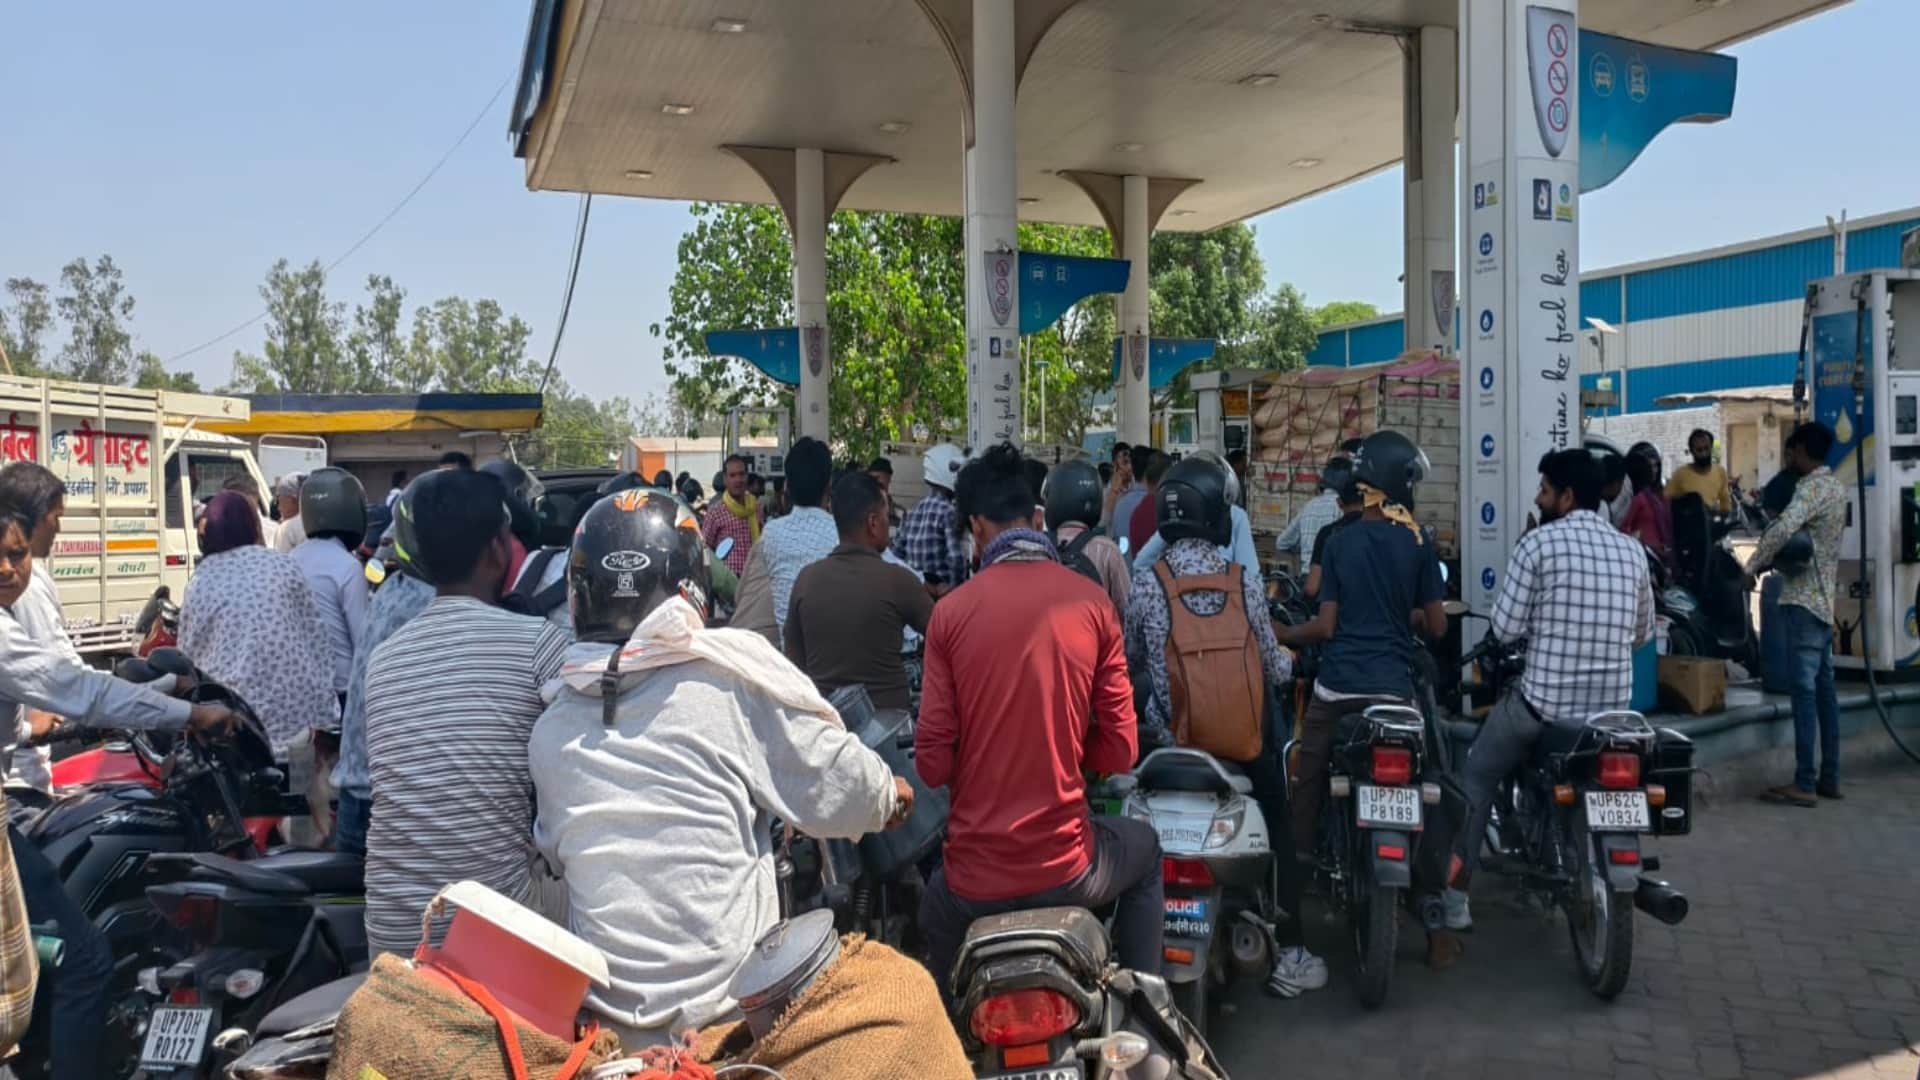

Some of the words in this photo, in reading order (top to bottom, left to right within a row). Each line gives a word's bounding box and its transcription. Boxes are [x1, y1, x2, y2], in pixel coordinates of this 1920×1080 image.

[1540, 297, 1574, 343] feel
[1370, 789, 1413, 805] UP70H
[1597, 792, 1639, 808] UP62C
[1370, 804, 1413, 821] P8189
[1599, 809, 1642, 824] V0834
[160, 1011, 203, 1035] UP70H
